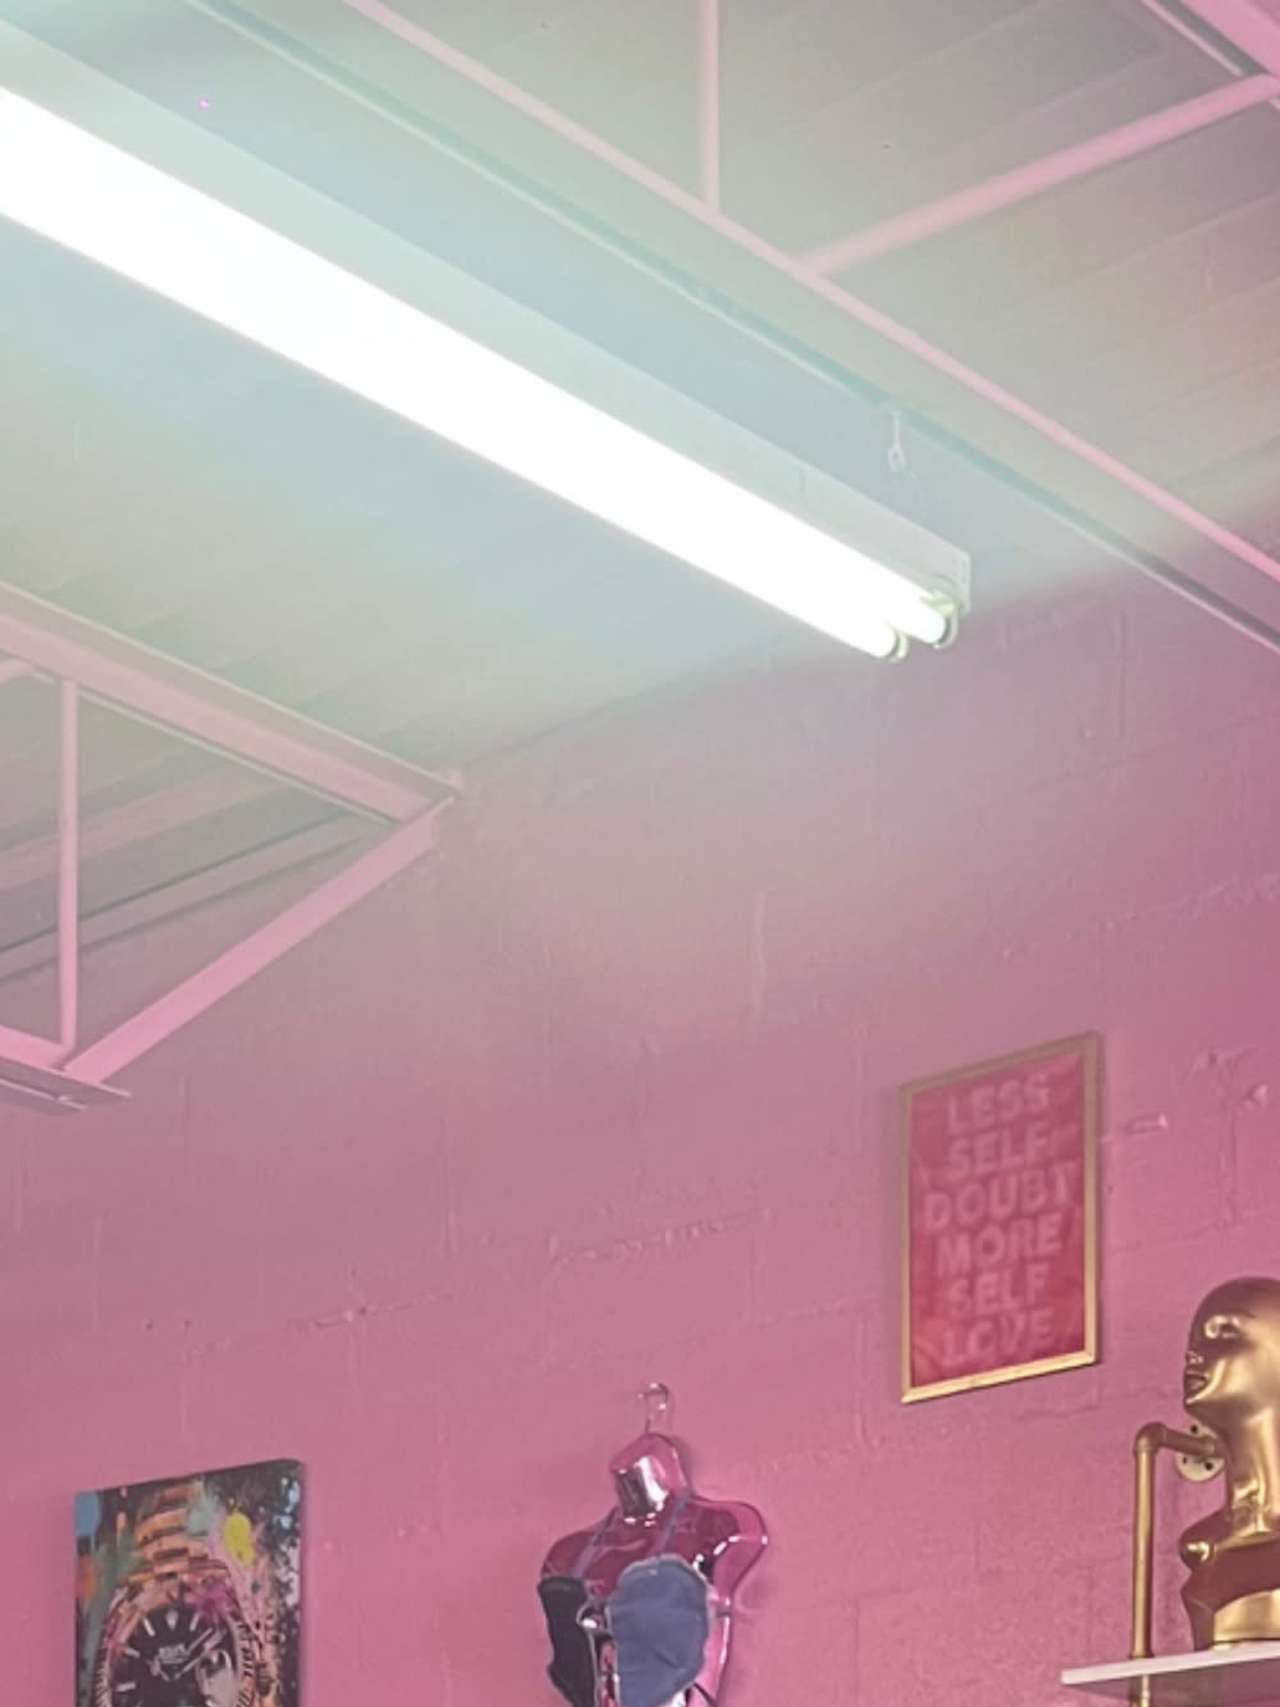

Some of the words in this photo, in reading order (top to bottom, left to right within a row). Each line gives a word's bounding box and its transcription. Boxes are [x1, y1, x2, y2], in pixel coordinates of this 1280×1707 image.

[948, 1072, 1050, 1128] LESS
[949, 1119, 1052, 1180] SELF
[924, 1160, 1078, 1231] DOUBT
[937, 1212, 1063, 1277] MORE
[949, 1261, 1050, 1320] SELF
[943, 1307, 1055, 1367] LOVE
